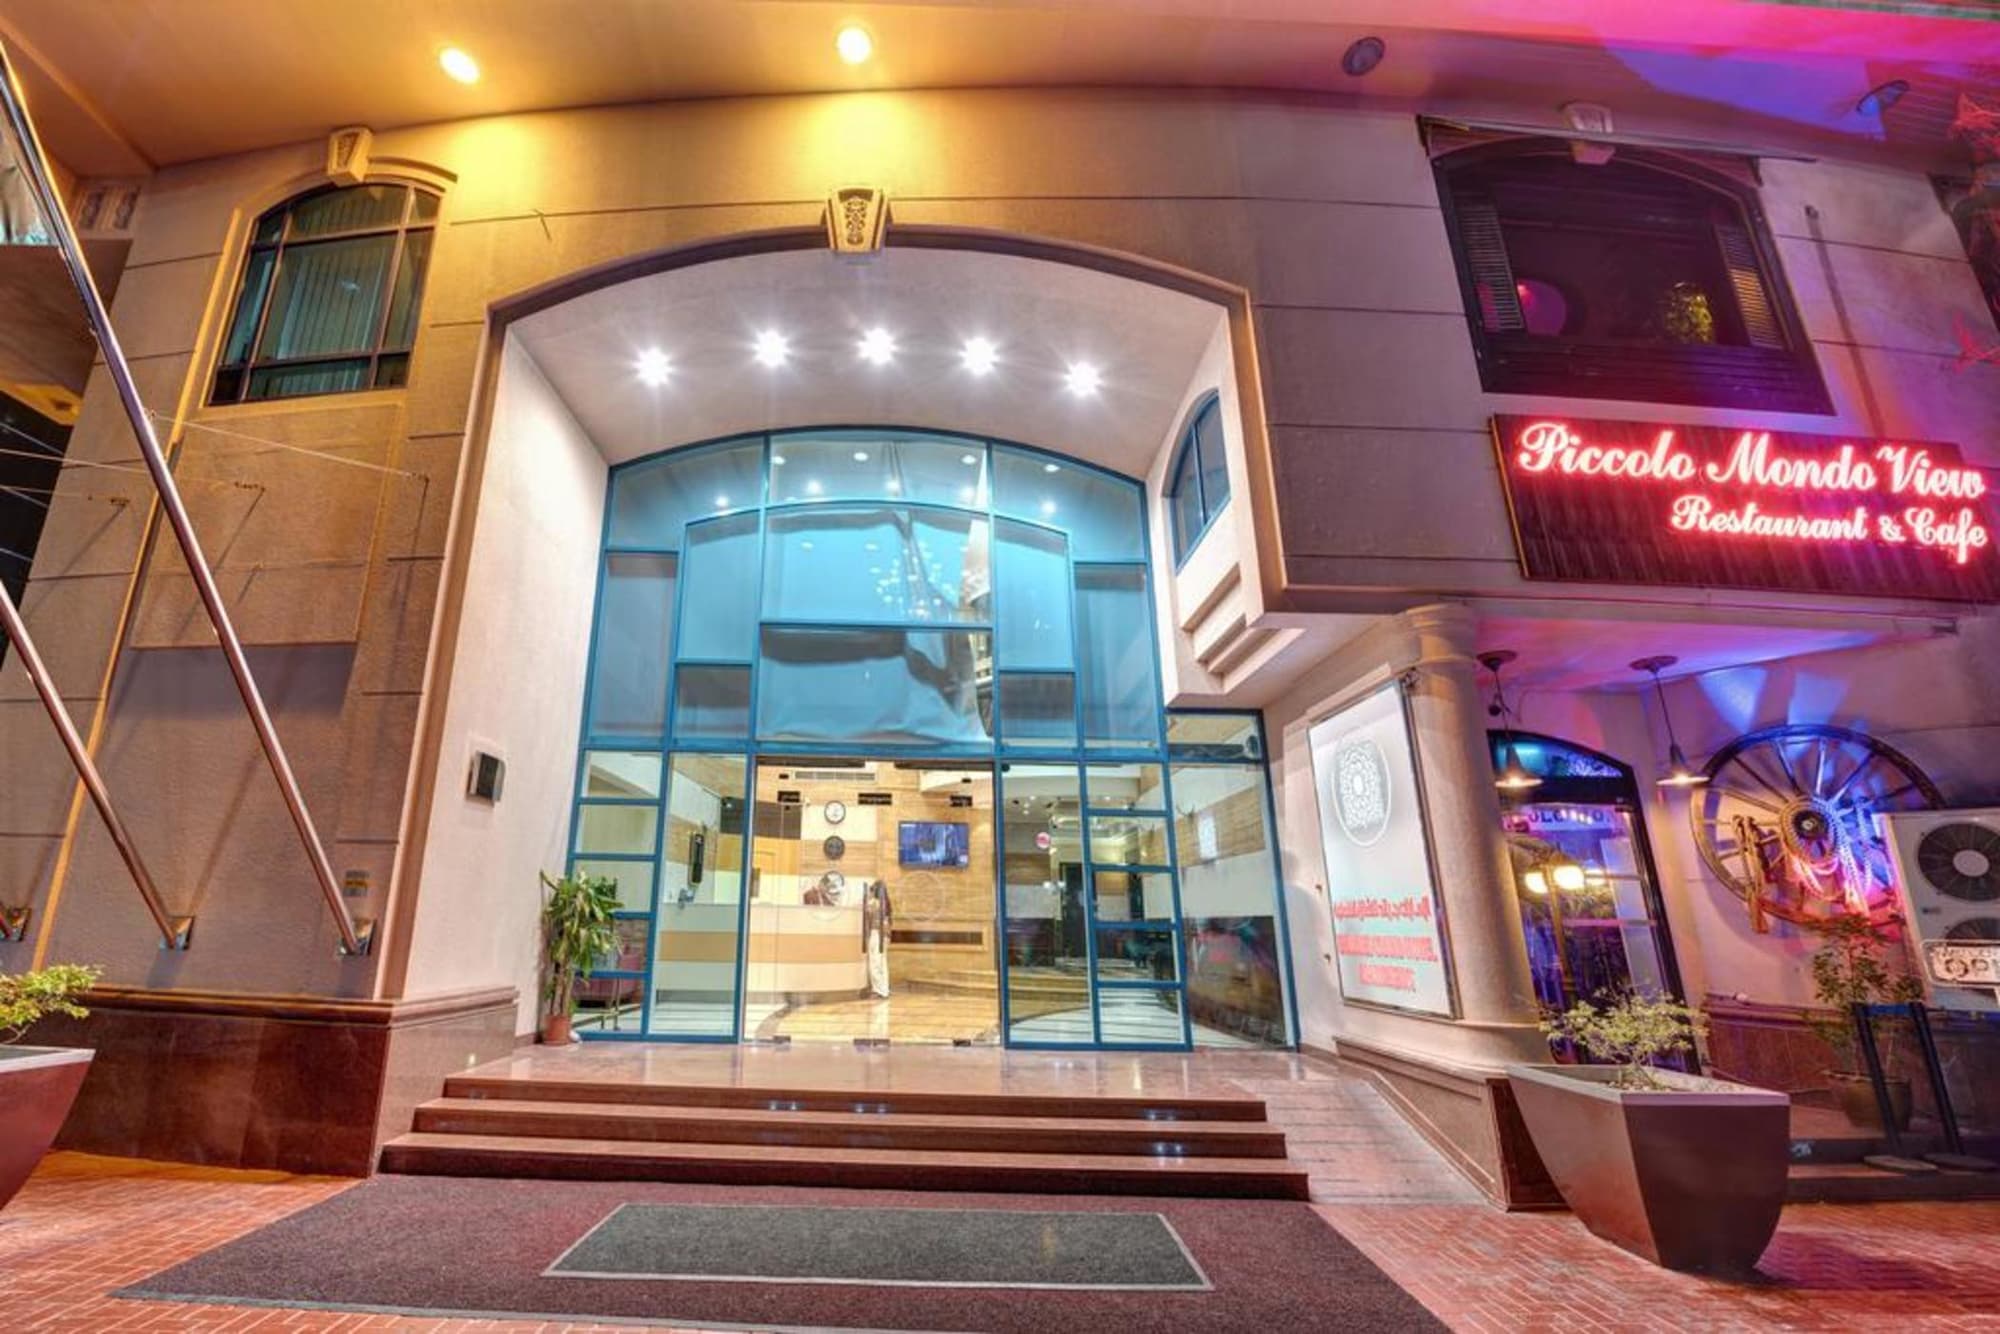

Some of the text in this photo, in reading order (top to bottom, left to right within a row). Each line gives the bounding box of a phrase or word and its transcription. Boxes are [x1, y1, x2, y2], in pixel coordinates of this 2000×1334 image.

[1519, 422, 1986, 499] Piccolo Mondo View
[1670, 495, 1988, 565] Restaurant & Cafe
